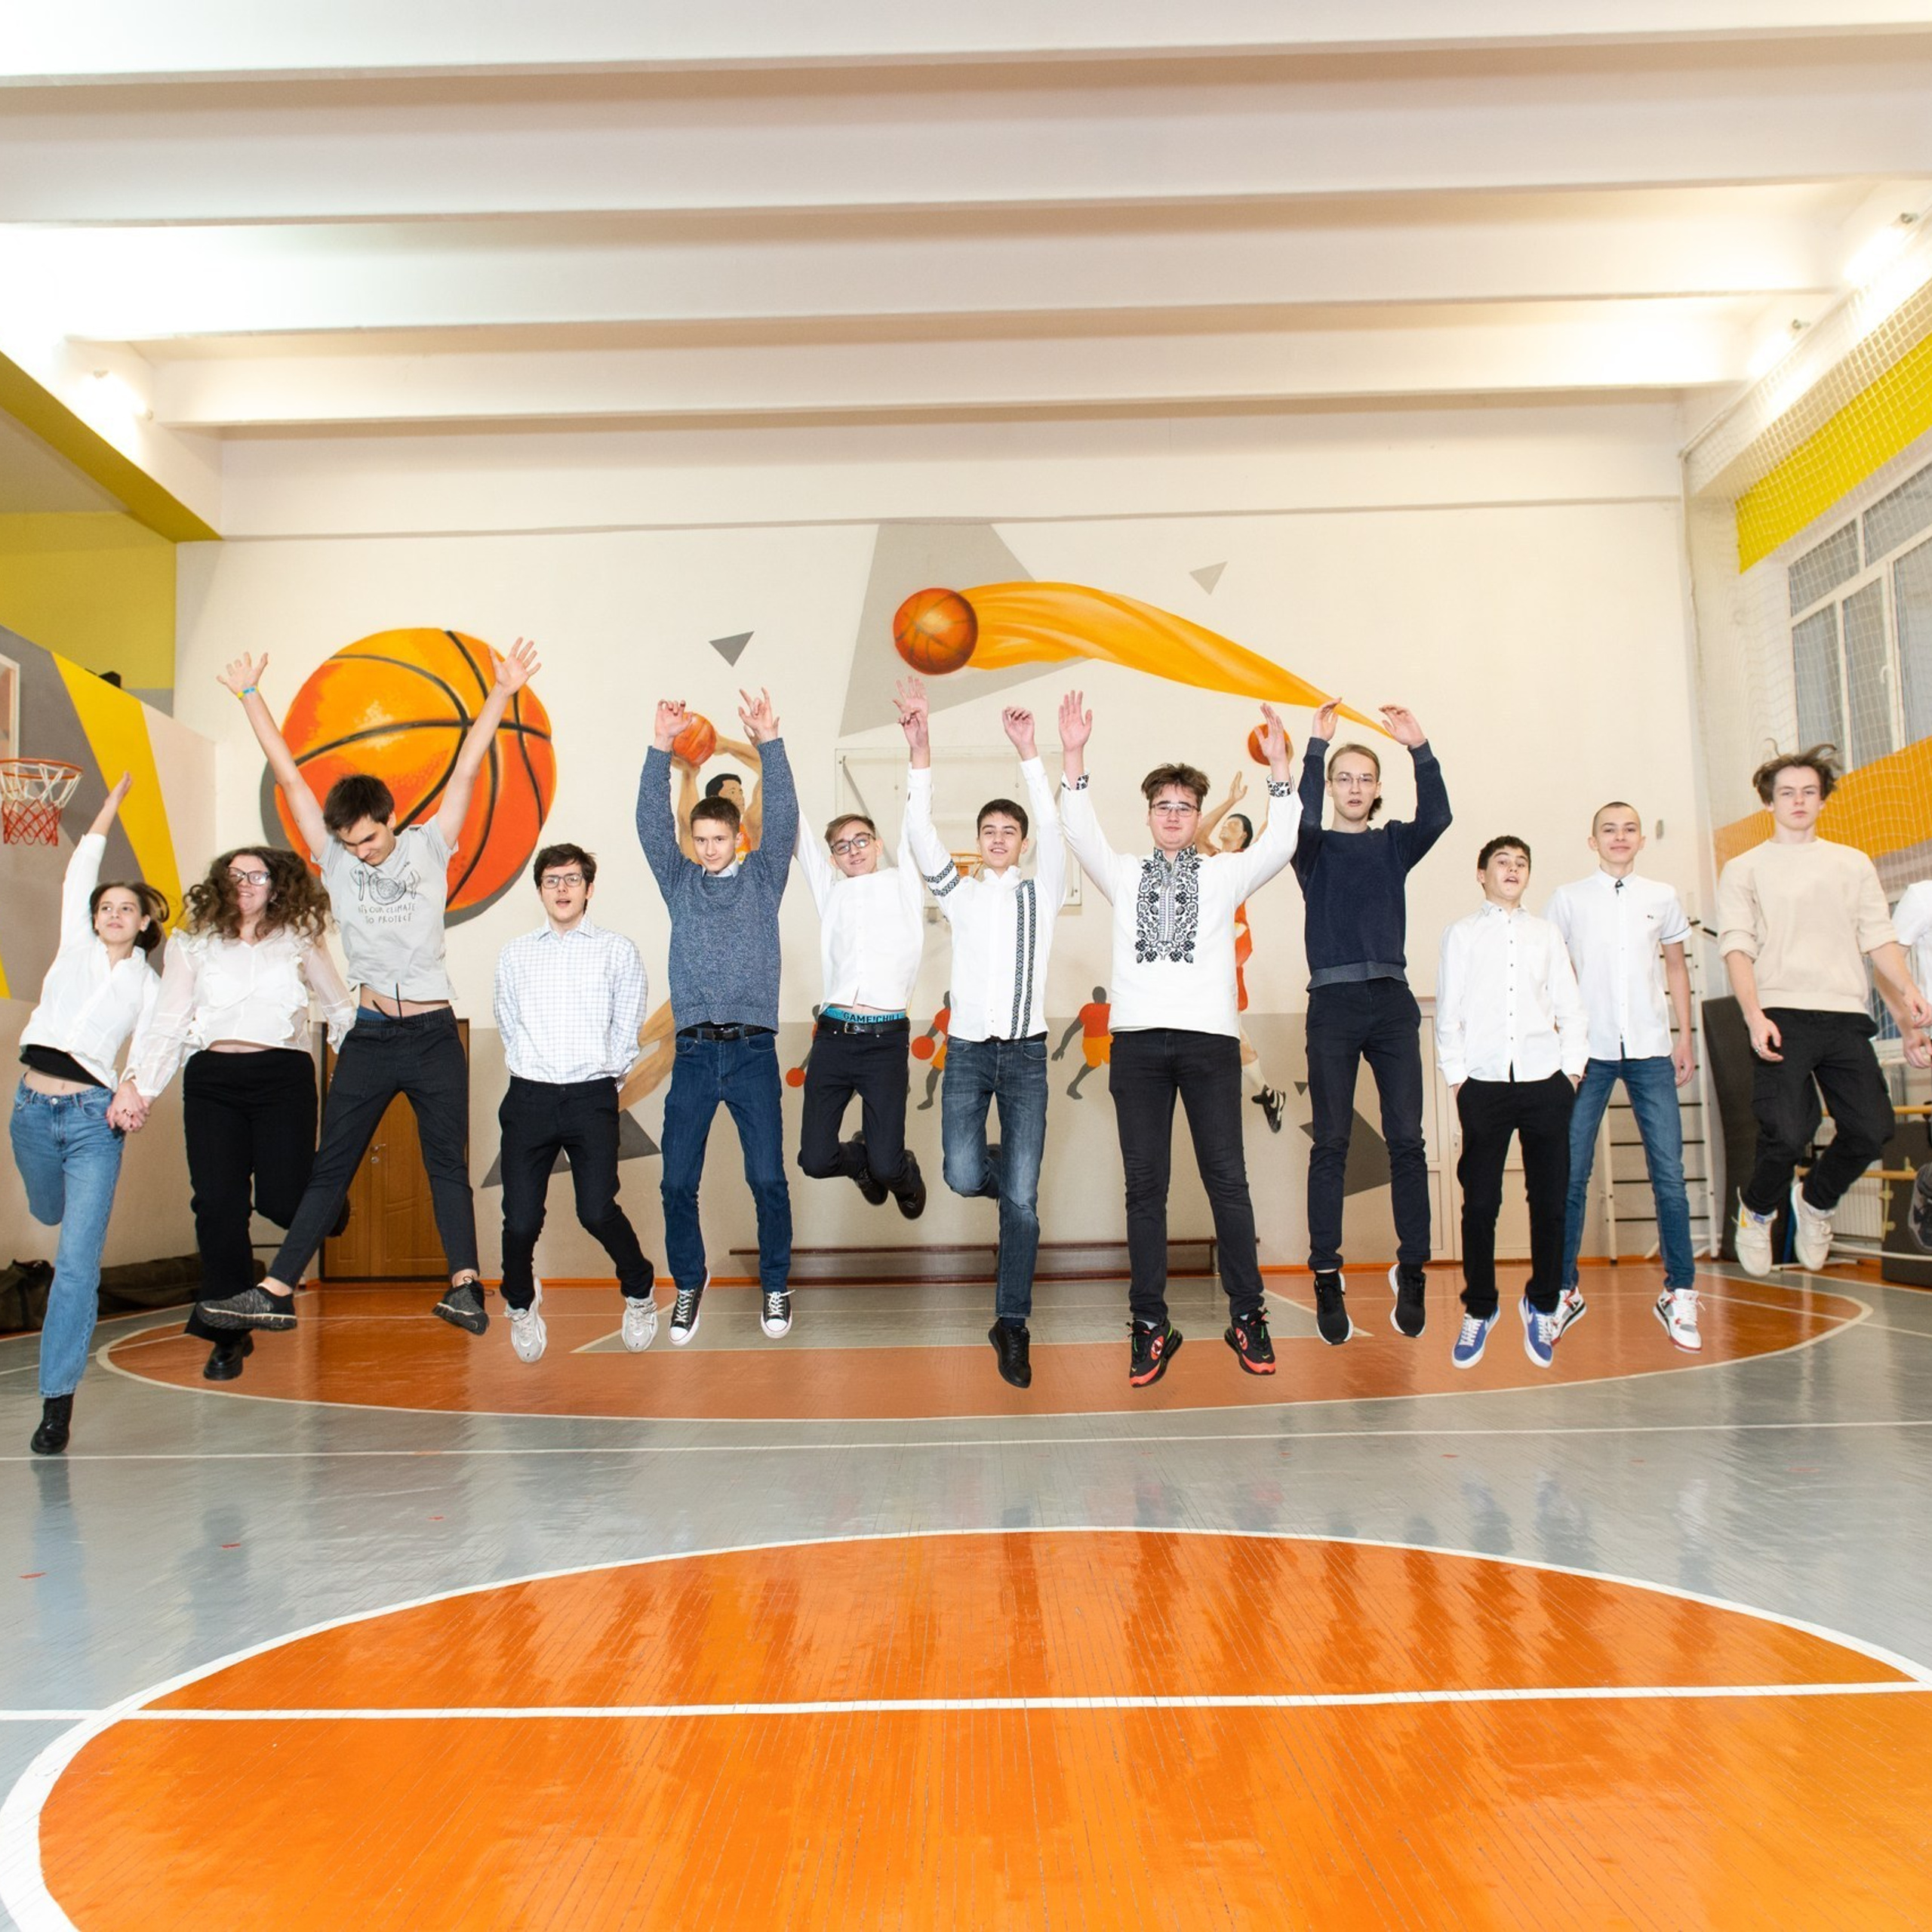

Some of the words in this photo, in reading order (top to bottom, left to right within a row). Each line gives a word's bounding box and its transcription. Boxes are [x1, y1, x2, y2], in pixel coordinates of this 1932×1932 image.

[386, 903, 415, 913] CLIMATE
[365, 915, 374, 924] TO
[378, 913, 411, 923] PROTECT
